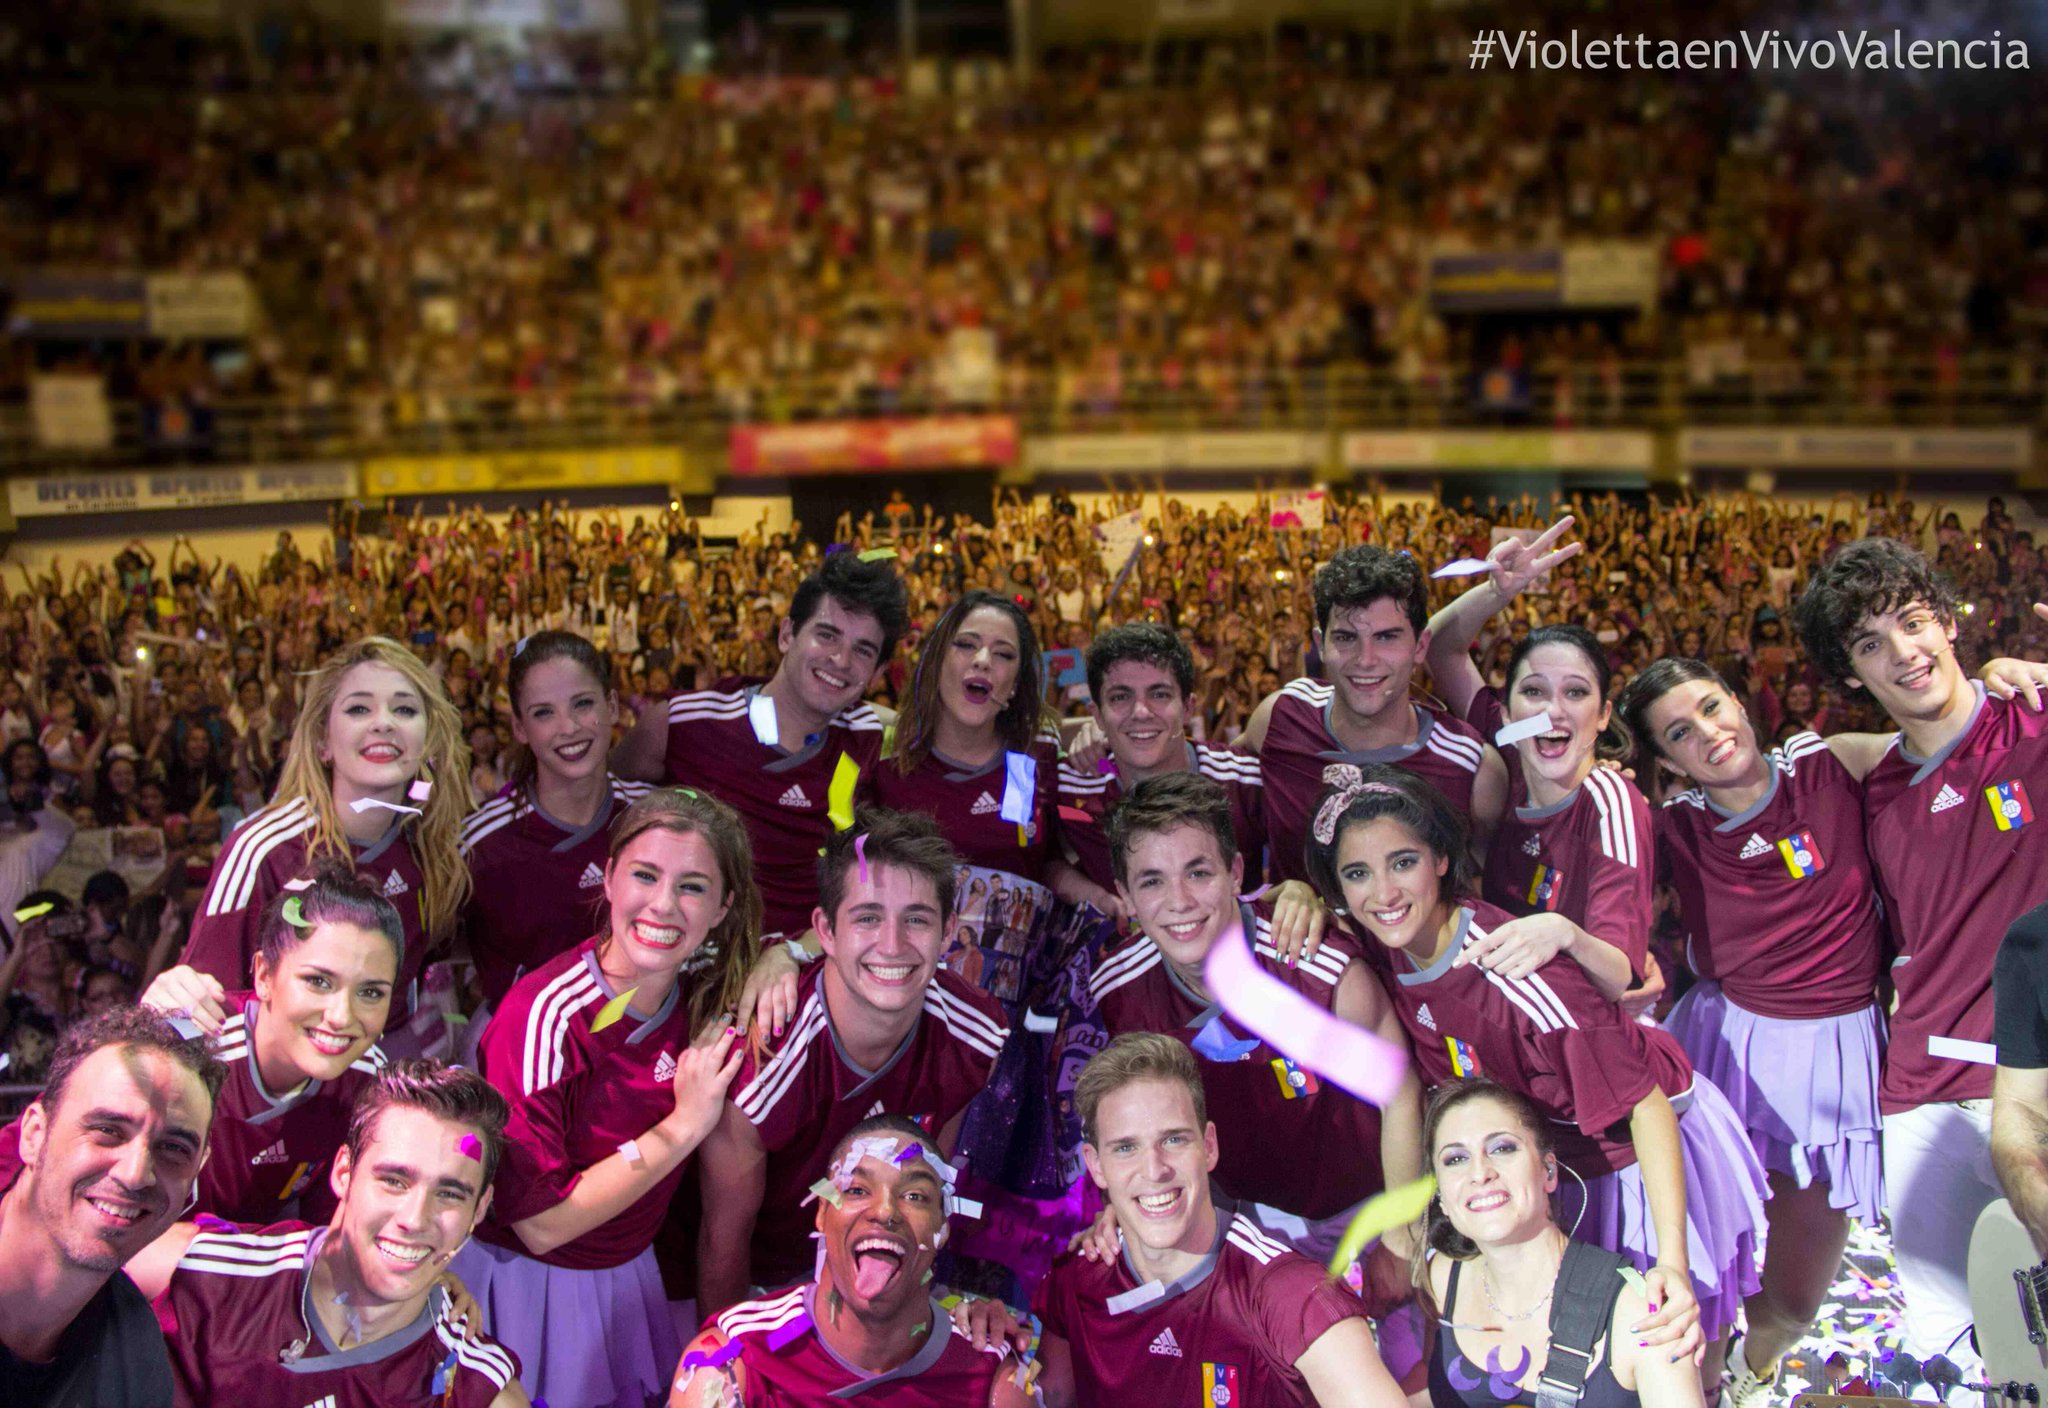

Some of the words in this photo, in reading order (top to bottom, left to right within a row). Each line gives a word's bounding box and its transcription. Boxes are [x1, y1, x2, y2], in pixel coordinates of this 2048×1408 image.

[778, 797, 812, 808] adidas
[1931, 795, 1965, 813] adidas
[1739, 843, 1774, 860] adidas
[1148, 1344, 1183, 1358] adidas
